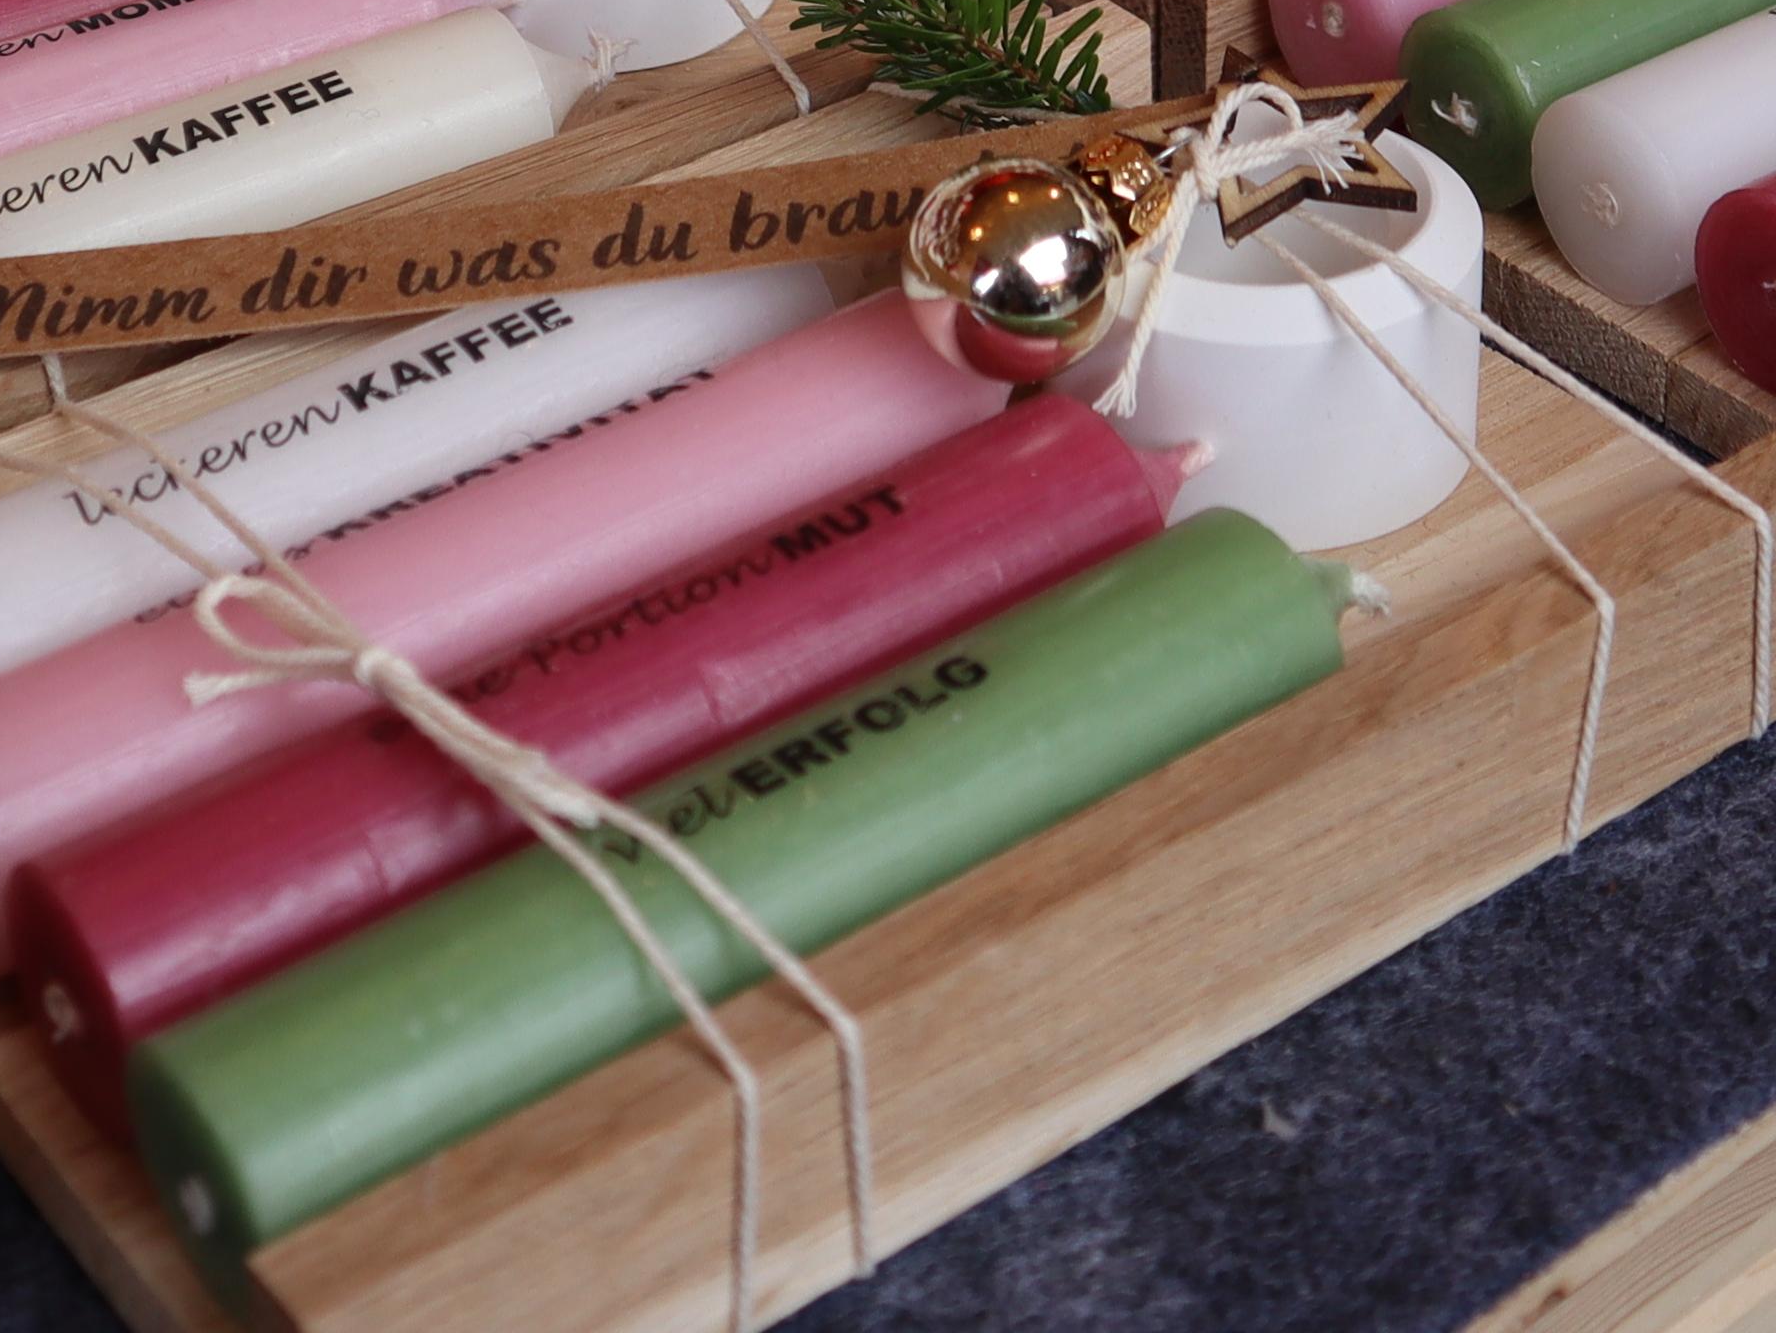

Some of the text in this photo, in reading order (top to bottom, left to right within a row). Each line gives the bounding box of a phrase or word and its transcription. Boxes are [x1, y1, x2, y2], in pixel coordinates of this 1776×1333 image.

[133, 69, 355, 165] KAFFEE
[239, 246, 369, 315] dir
[395, 238, 562, 299] was
[592, 202, 701, 270] du
[337, 297, 575, 413] KAFFEE
[770, 483, 906, 562] MUT
[600, 655, 990, 866] vel ERFOLG
